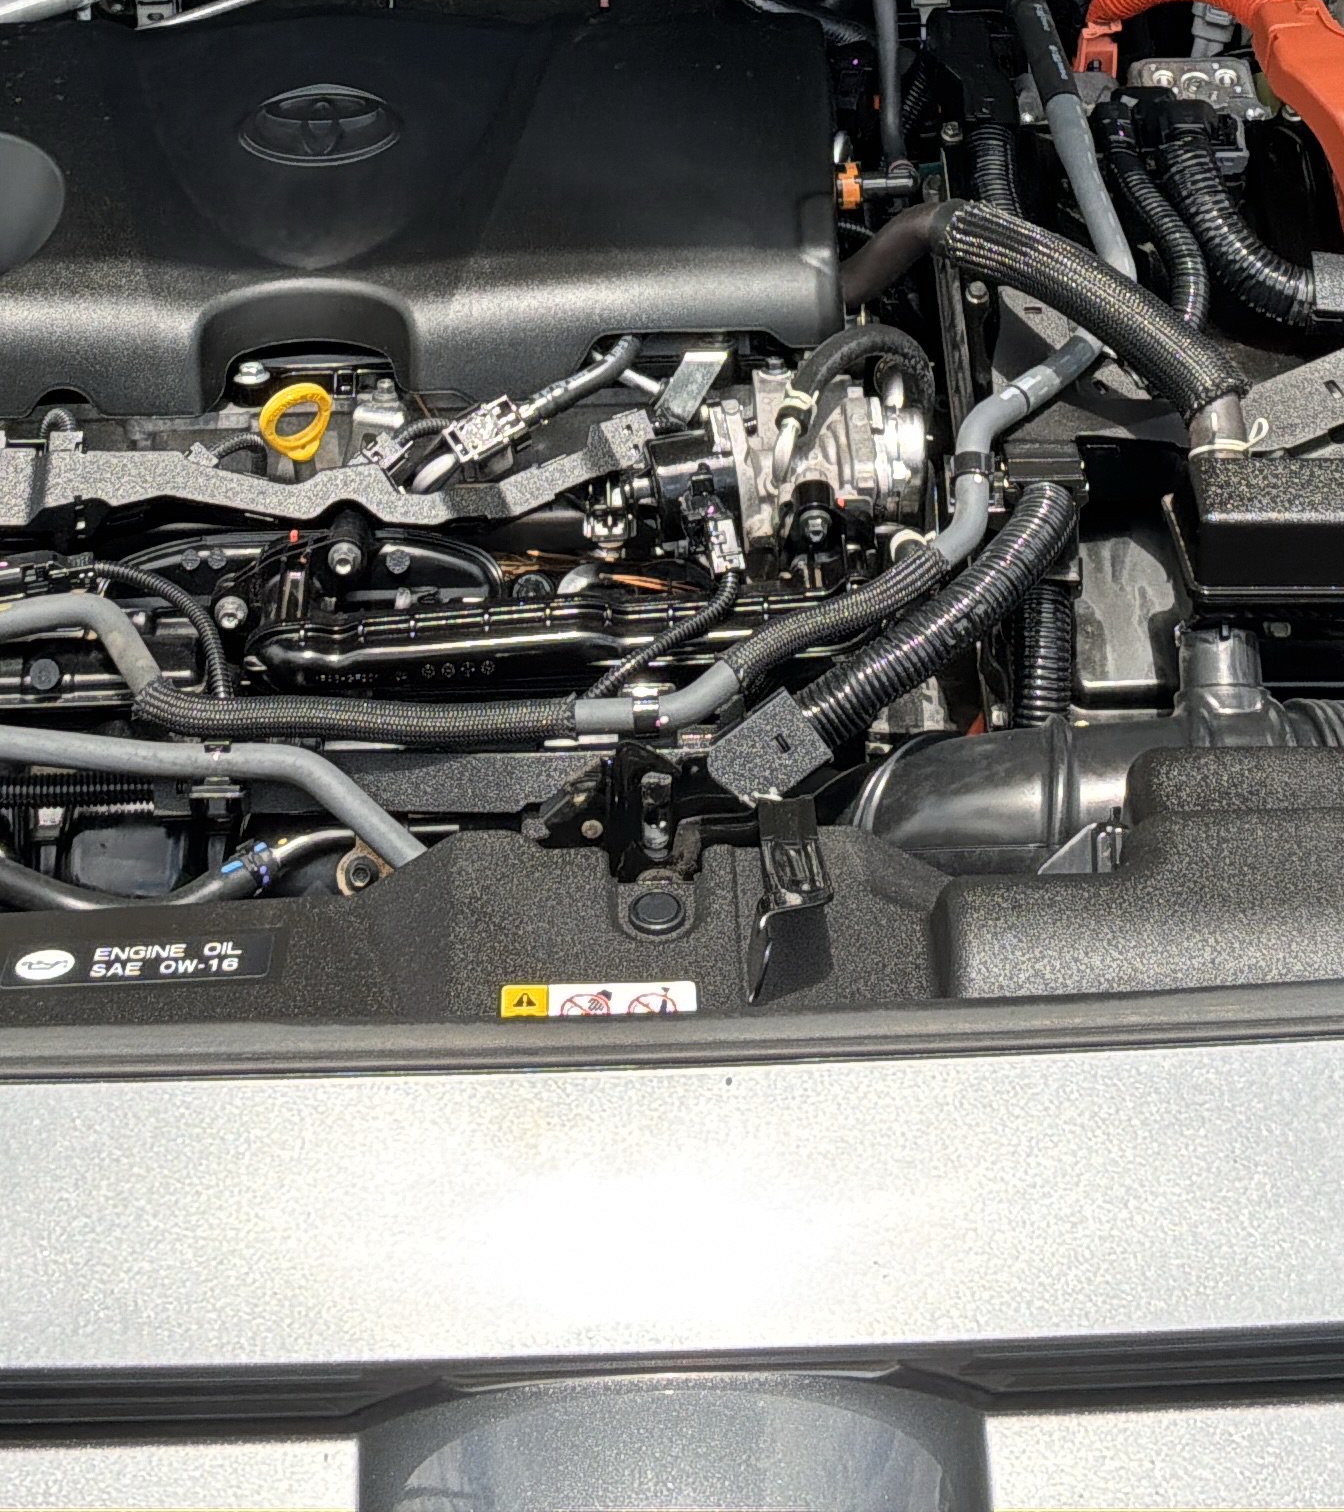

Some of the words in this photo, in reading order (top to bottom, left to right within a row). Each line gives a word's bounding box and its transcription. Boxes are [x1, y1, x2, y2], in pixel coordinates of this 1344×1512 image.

[93, 944, 187, 961] ENGINE
[203, 941, 242, 956] OIL
[89, 961, 143, 978] SAE
[159, 957, 239, 974] 0W-16
